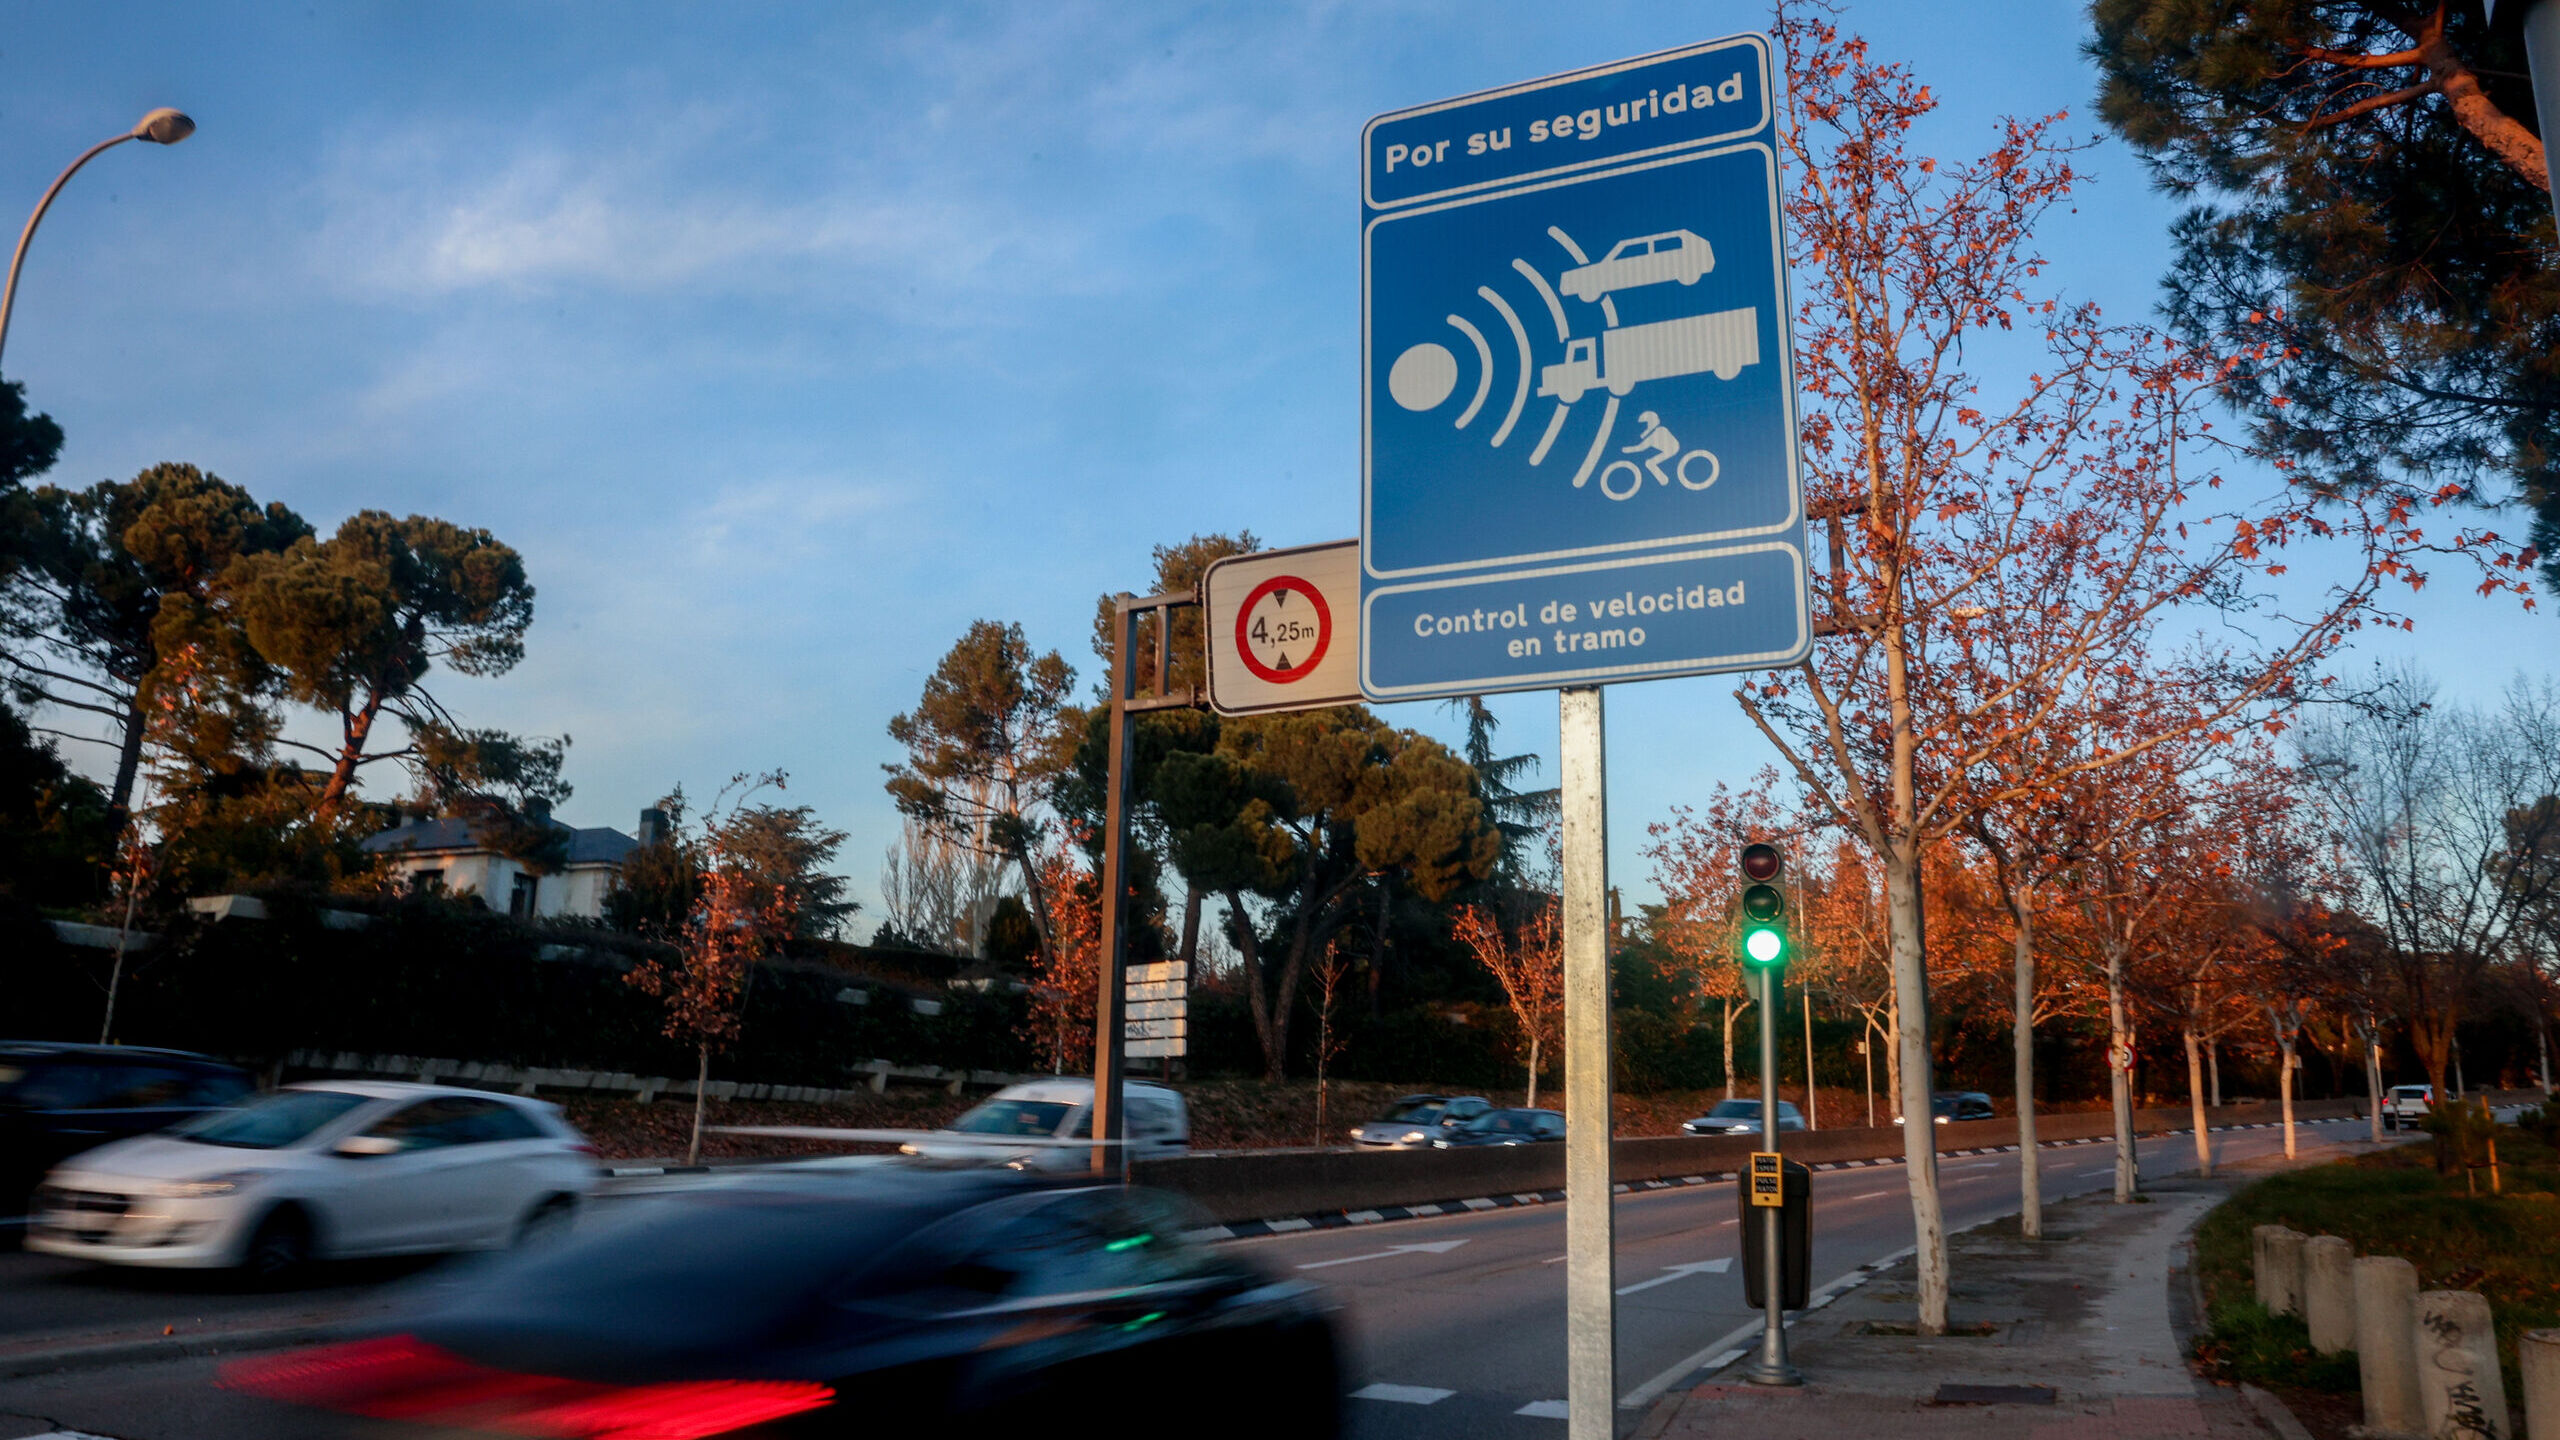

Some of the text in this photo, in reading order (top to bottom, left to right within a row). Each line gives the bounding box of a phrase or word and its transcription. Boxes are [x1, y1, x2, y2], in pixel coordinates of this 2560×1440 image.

[1386, 72, 1743, 173] Por su seguridad
[1414, 580, 1745, 637] Control de velocidad
[1507, 627, 1646, 658] en tramo
